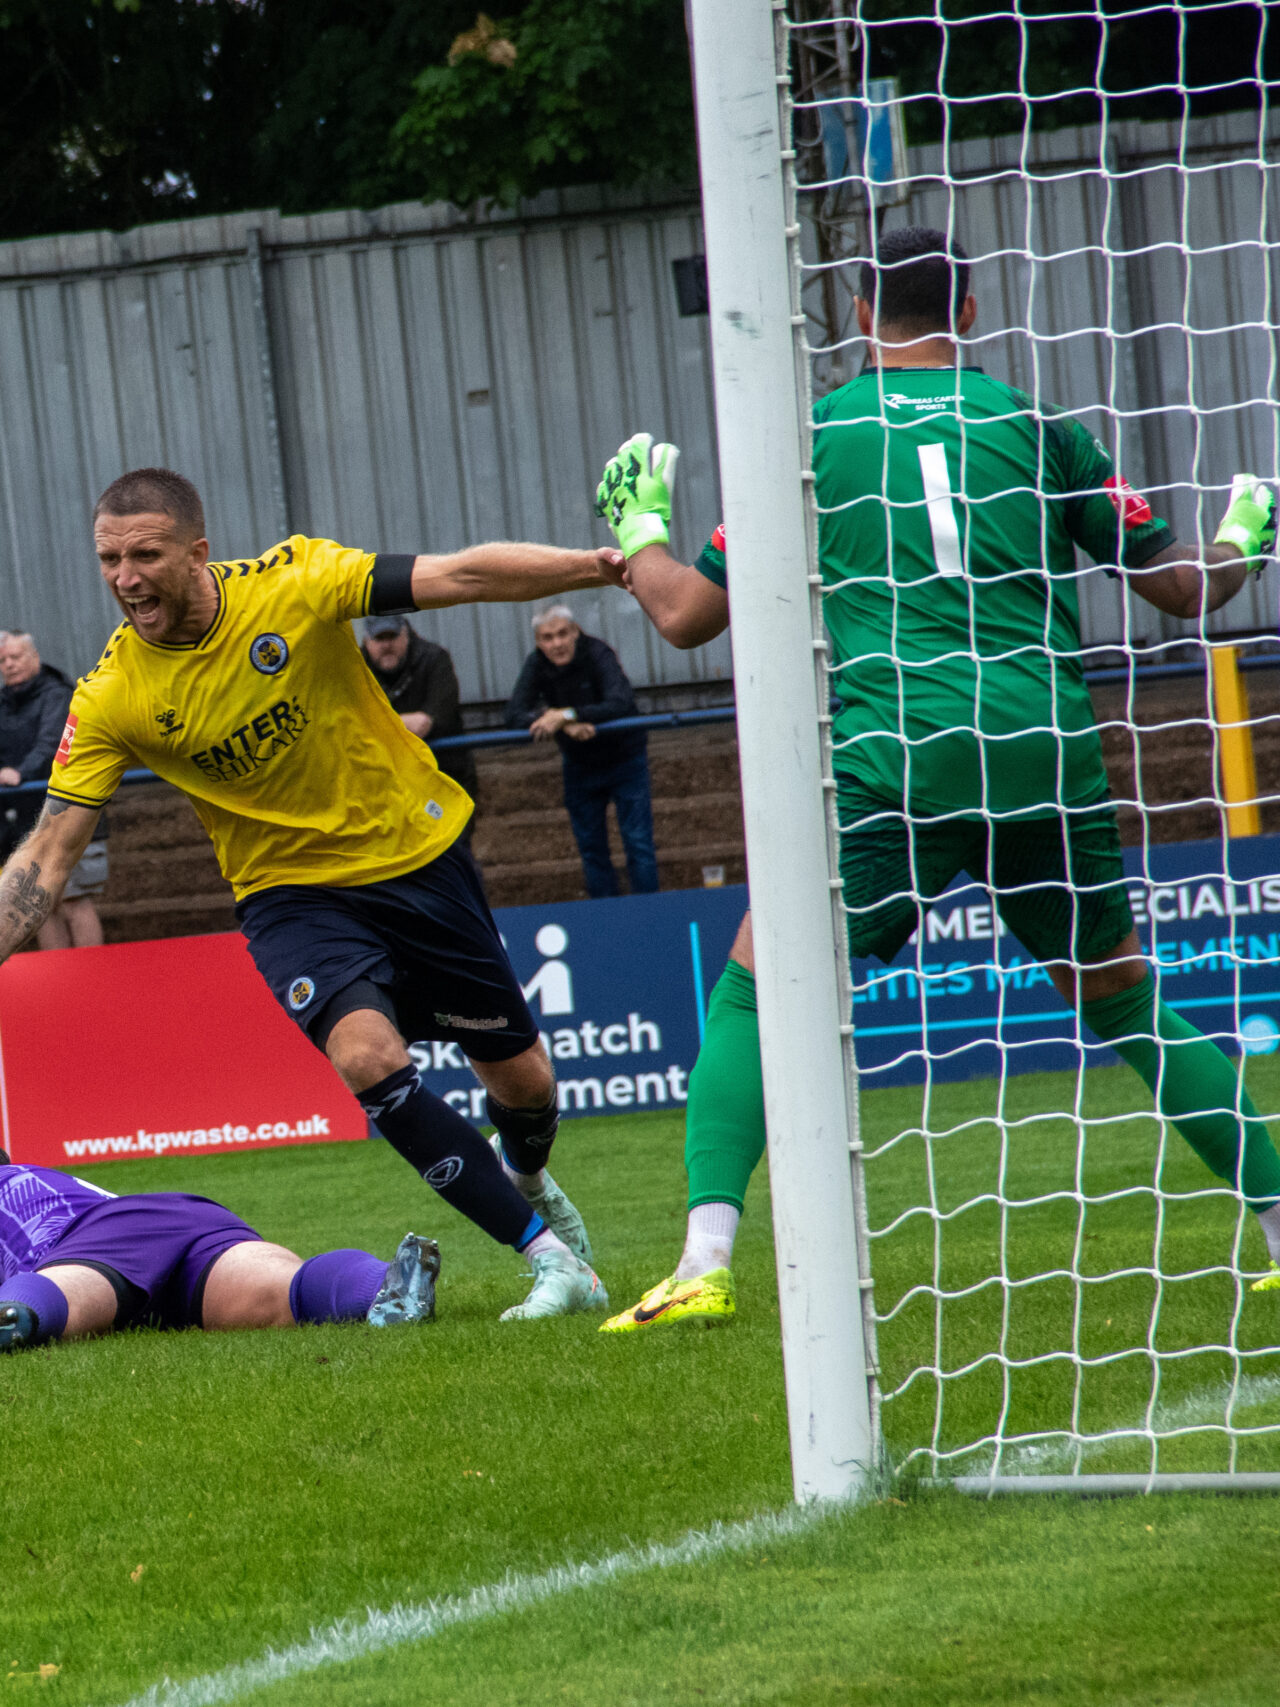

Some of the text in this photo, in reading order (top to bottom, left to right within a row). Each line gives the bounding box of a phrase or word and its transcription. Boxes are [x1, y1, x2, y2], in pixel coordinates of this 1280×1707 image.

[915, 403, 947, 411] SPORTS
[934, 395, 965, 404] CARTR
[917, 442, 964, 577] 1
[204, 709, 311, 783] SHIKARI
[64, 1114, 331, 1158] www.kpwaste.co.uk
